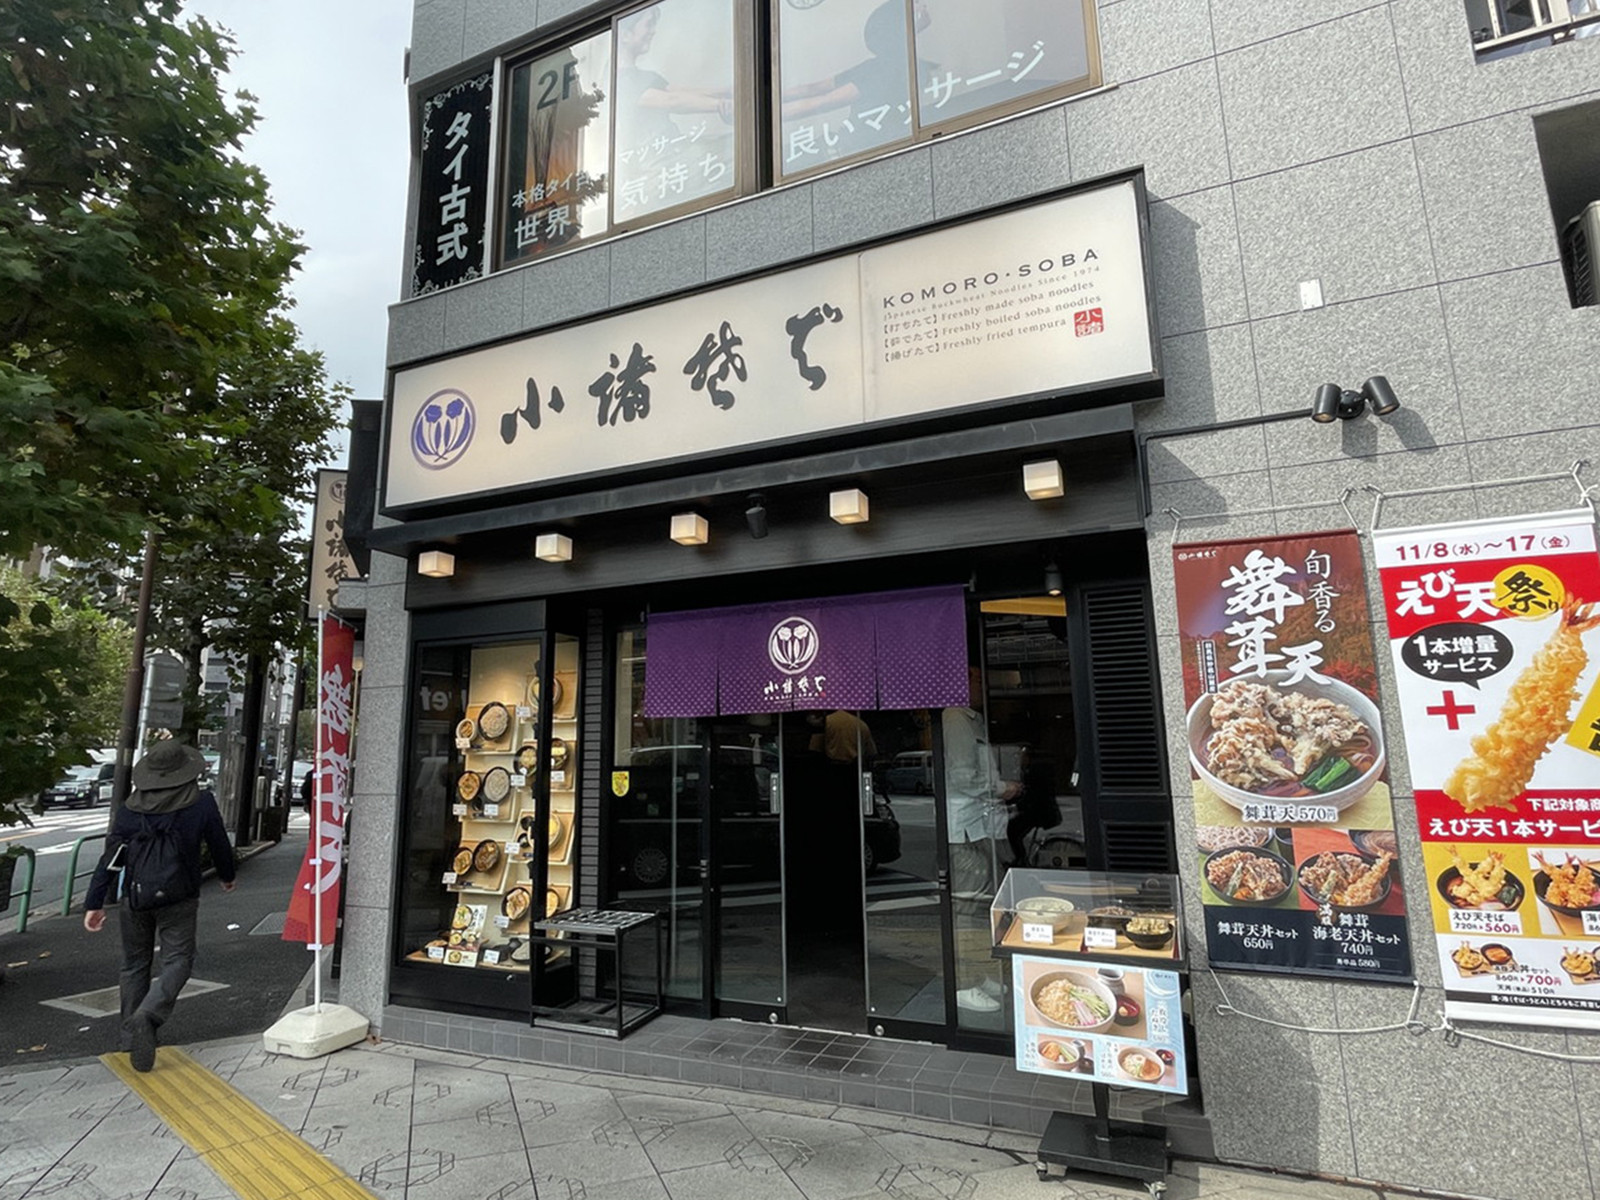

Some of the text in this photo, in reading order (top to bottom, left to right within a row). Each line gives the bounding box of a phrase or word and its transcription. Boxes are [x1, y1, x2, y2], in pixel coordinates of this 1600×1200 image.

[537, 60, 579, 110] 2F
[619, 120, 706, 164] マッサージ
[435, 110, 472, 266] タイ古式
[619, 152, 726, 211] 気持ち
[990, 283, 1032, 297] Noodles
[1037, 274, 1067, 286] Since
[1073, 266, 1100, 278] 1974
[941, 306, 980, 321] Freshly
[985, 298, 1014, 312] made
[1018, 293, 1044, 305] soba
[1049, 281, 1094, 297] noodles
[942, 321, 981, 336] Freshly
[985, 312, 1021, 327] boiled
[1025, 305, 1051, 317] soba
[1055, 295, 1101, 312] noodles
[943, 336, 983, 350] Freshly
[987, 328, 1014, 341] fried
[1018, 318, 1066, 334] tempura
[1304, 549, 1340, 633] 旬香る
[1412, 634, 1499, 657] 1本増量
[1423, 656, 1497, 675] サービス
[1453, 911, 1504, 923] えび天そば
[1484, 923, 1519, 934] 560円
[1243, 937, 1273, 950] 650円
[1341, 942, 1373, 956] 740円
[1525, 974, 1561, 986] 700円
